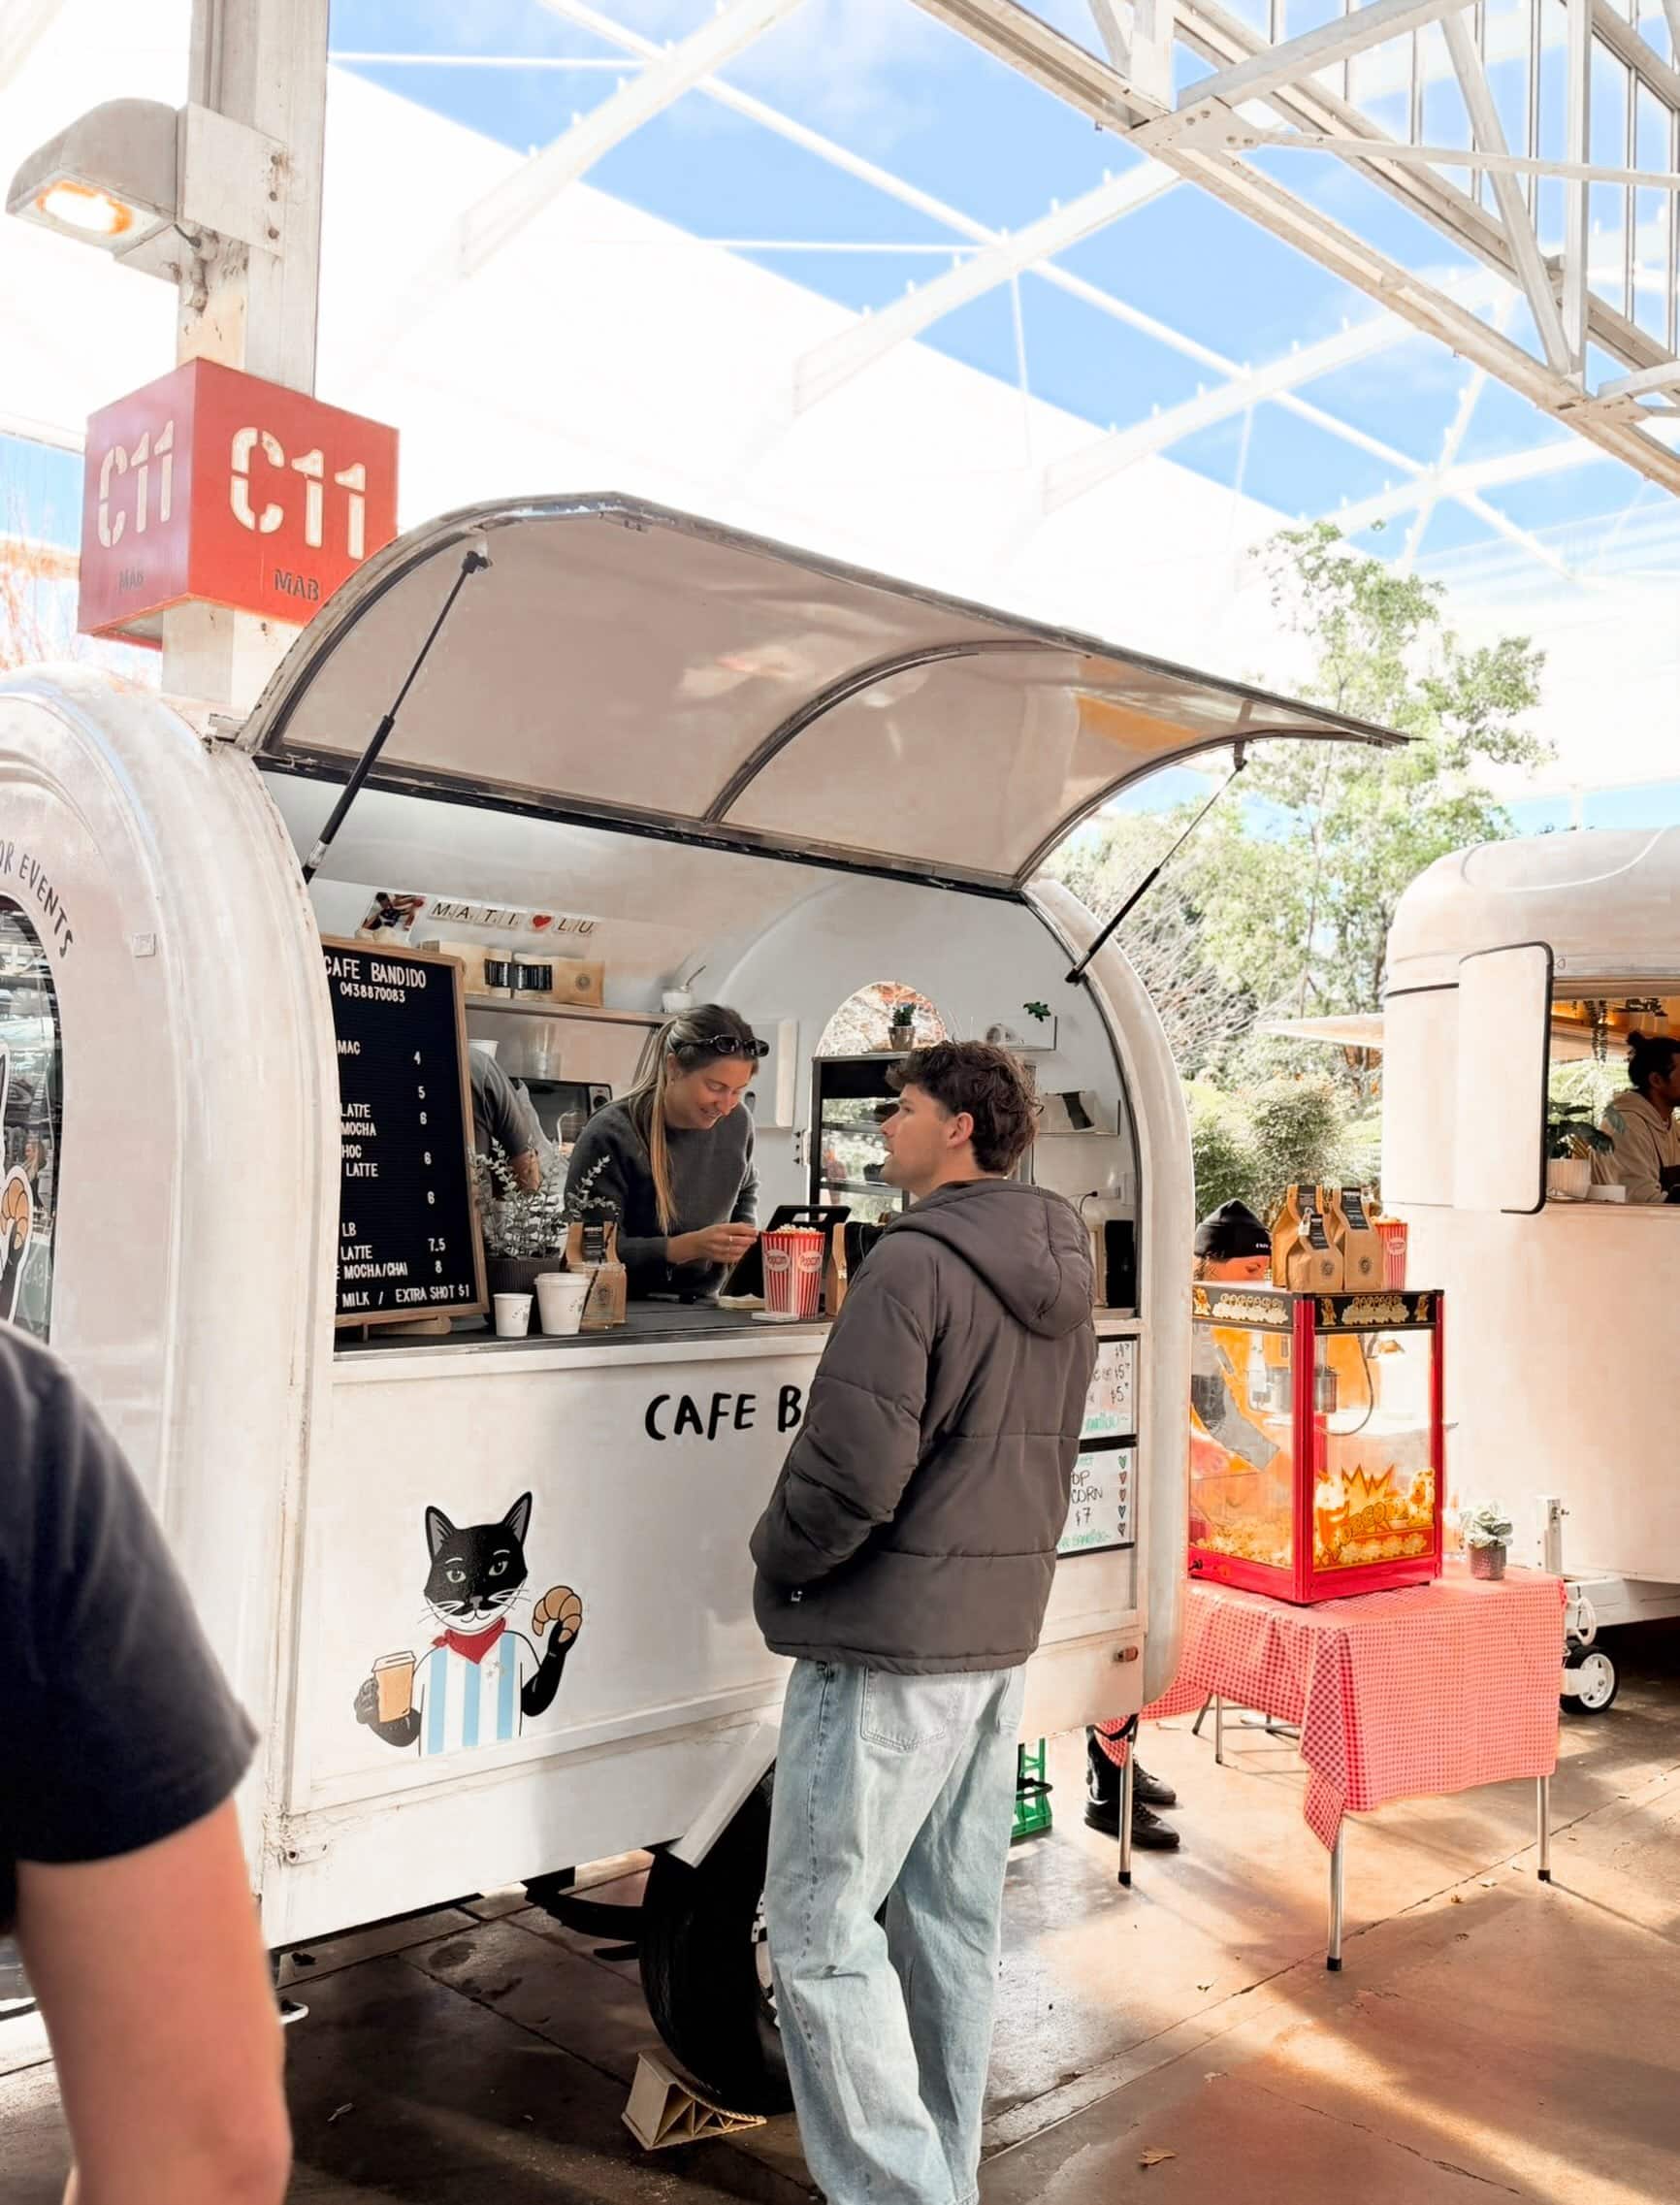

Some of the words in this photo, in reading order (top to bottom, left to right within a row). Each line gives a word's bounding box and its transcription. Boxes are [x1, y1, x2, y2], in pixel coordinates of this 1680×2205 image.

[98, 420, 175, 548] C11
[229, 426, 367, 561] C11
[274, 568, 320, 602] MAB
[19, 853, 74, 958] EVENTS
[324, 956, 361, 980] CAFE
[371, 961, 427, 989] BANDIDO
[339, 981, 405, 1003] 0438870083
[413, 1051, 421, 1065] 4
[418, 1086, 426, 1099] 5
[340, 1103, 372, 1118] LATTE
[340, 1121, 376, 1136] MOCHA
[424, 1151, 432, 1165] 6
[346, 1163, 379, 1177] LATTE
[427, 1190, 436, 1204] 6
[340, 1245, 372, 1260] LATTE
[428, 1238, 446, 1251] 7.5
[344, 1262, 408, 1280] MOCHA/CHAI
[435, 1260, 442, 1274] 8
[342, 1291, 370, 1308] MILK
[395, 1286, 427, 1303] EXTRA
[430, 1284, 455, 1300] SHOT
[458, 1283, 469, 1298] $1
[644, 1392, 757, 1441] CAFE
[1071, 1485, 1103, 1504] CORN
